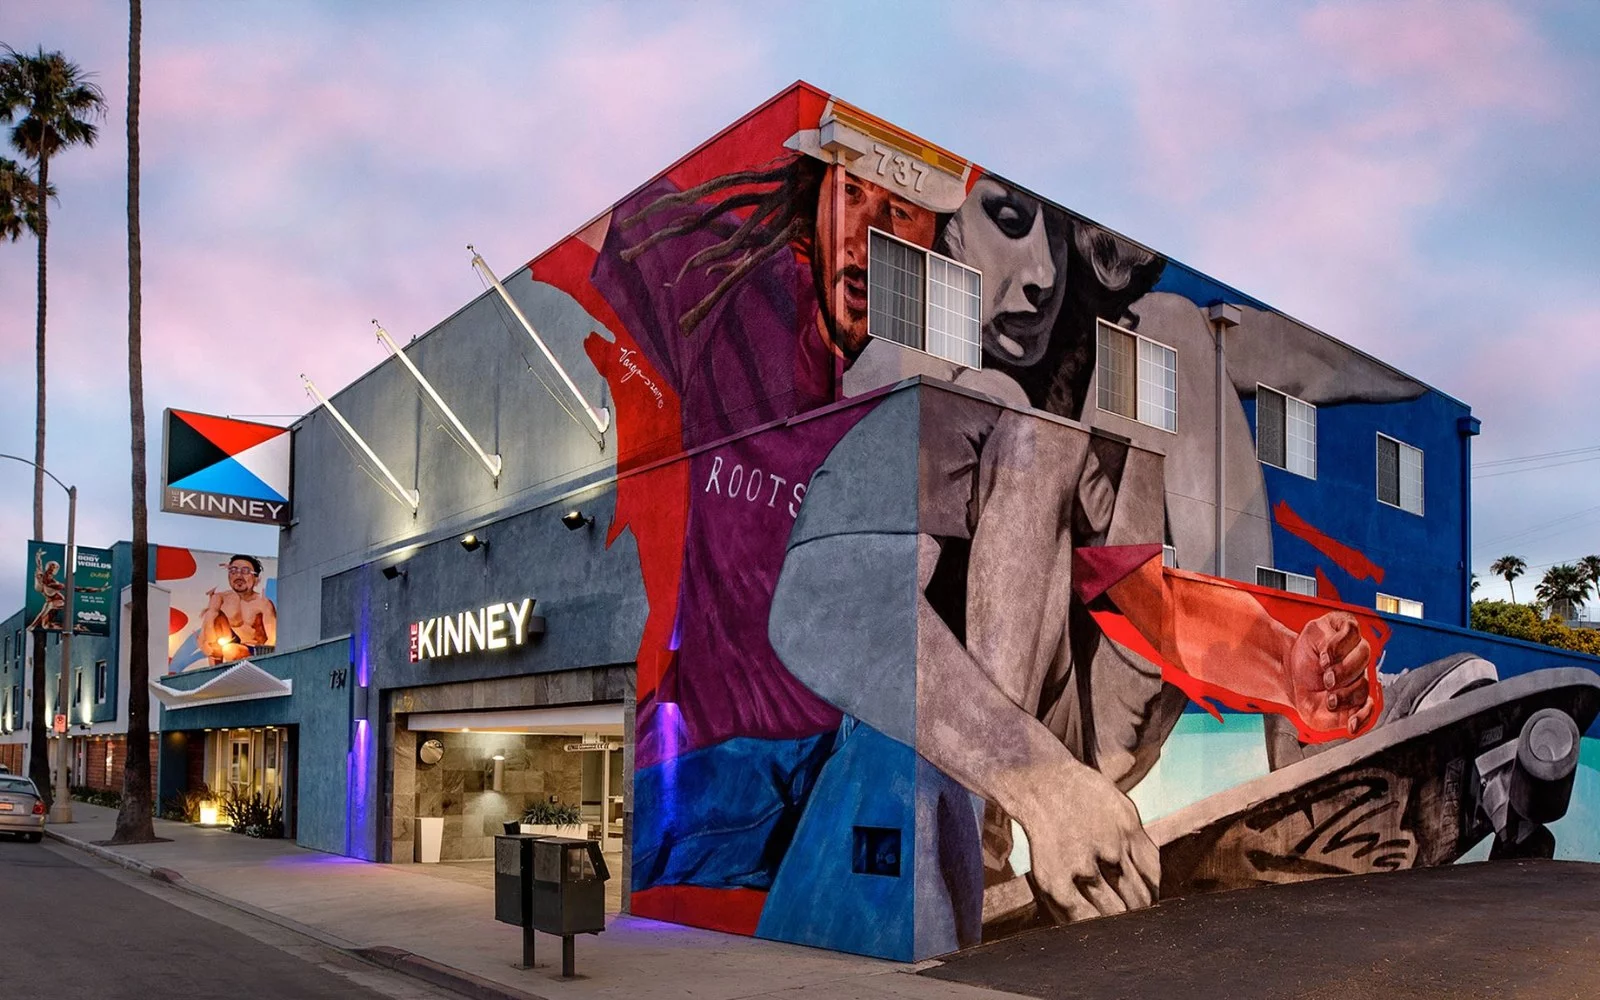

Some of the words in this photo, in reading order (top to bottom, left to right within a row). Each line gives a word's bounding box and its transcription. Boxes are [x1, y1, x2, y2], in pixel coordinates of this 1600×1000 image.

[874, 144, 929, 193] 737
[180, 491, 283, 519] KINNEY
[705, 456, 807, 518] ROOTS
[78, 561, 112, 569] WORLDS
[409, 623, 418, 662] THE
[418, 598, 536, 660] KINNEY
